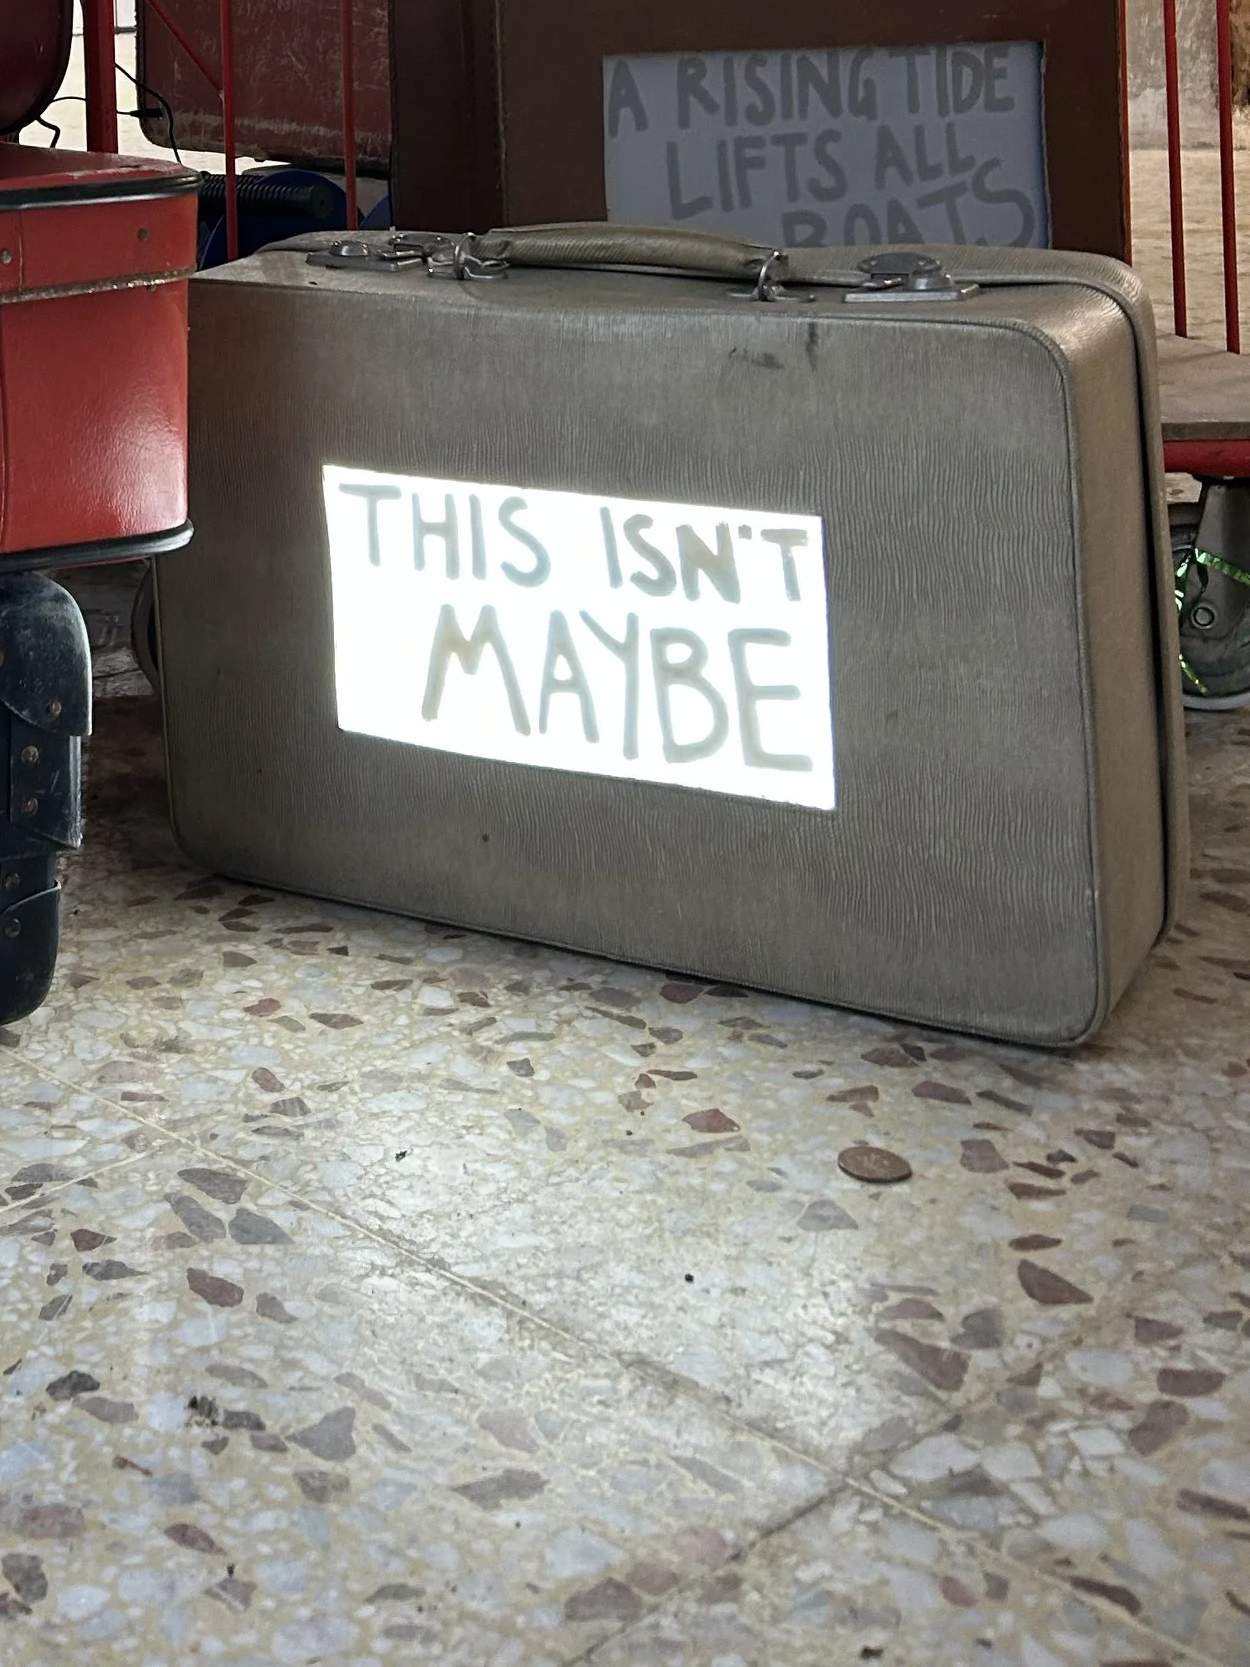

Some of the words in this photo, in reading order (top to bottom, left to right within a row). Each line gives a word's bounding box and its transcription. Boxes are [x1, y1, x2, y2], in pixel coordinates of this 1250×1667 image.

[607, 56, 649, 139] A
[676, 46, 878, 130] RISING
[887, 43, 1016, 120] TIDE
[665, 129, 849, 221] LIFTS
[874, 122, 976, 191] ALL
[338, 482, 552, 590] THIS
[598, 504, 810, 605] ISN'T
[420, 603, 815, 774] MAYBE
